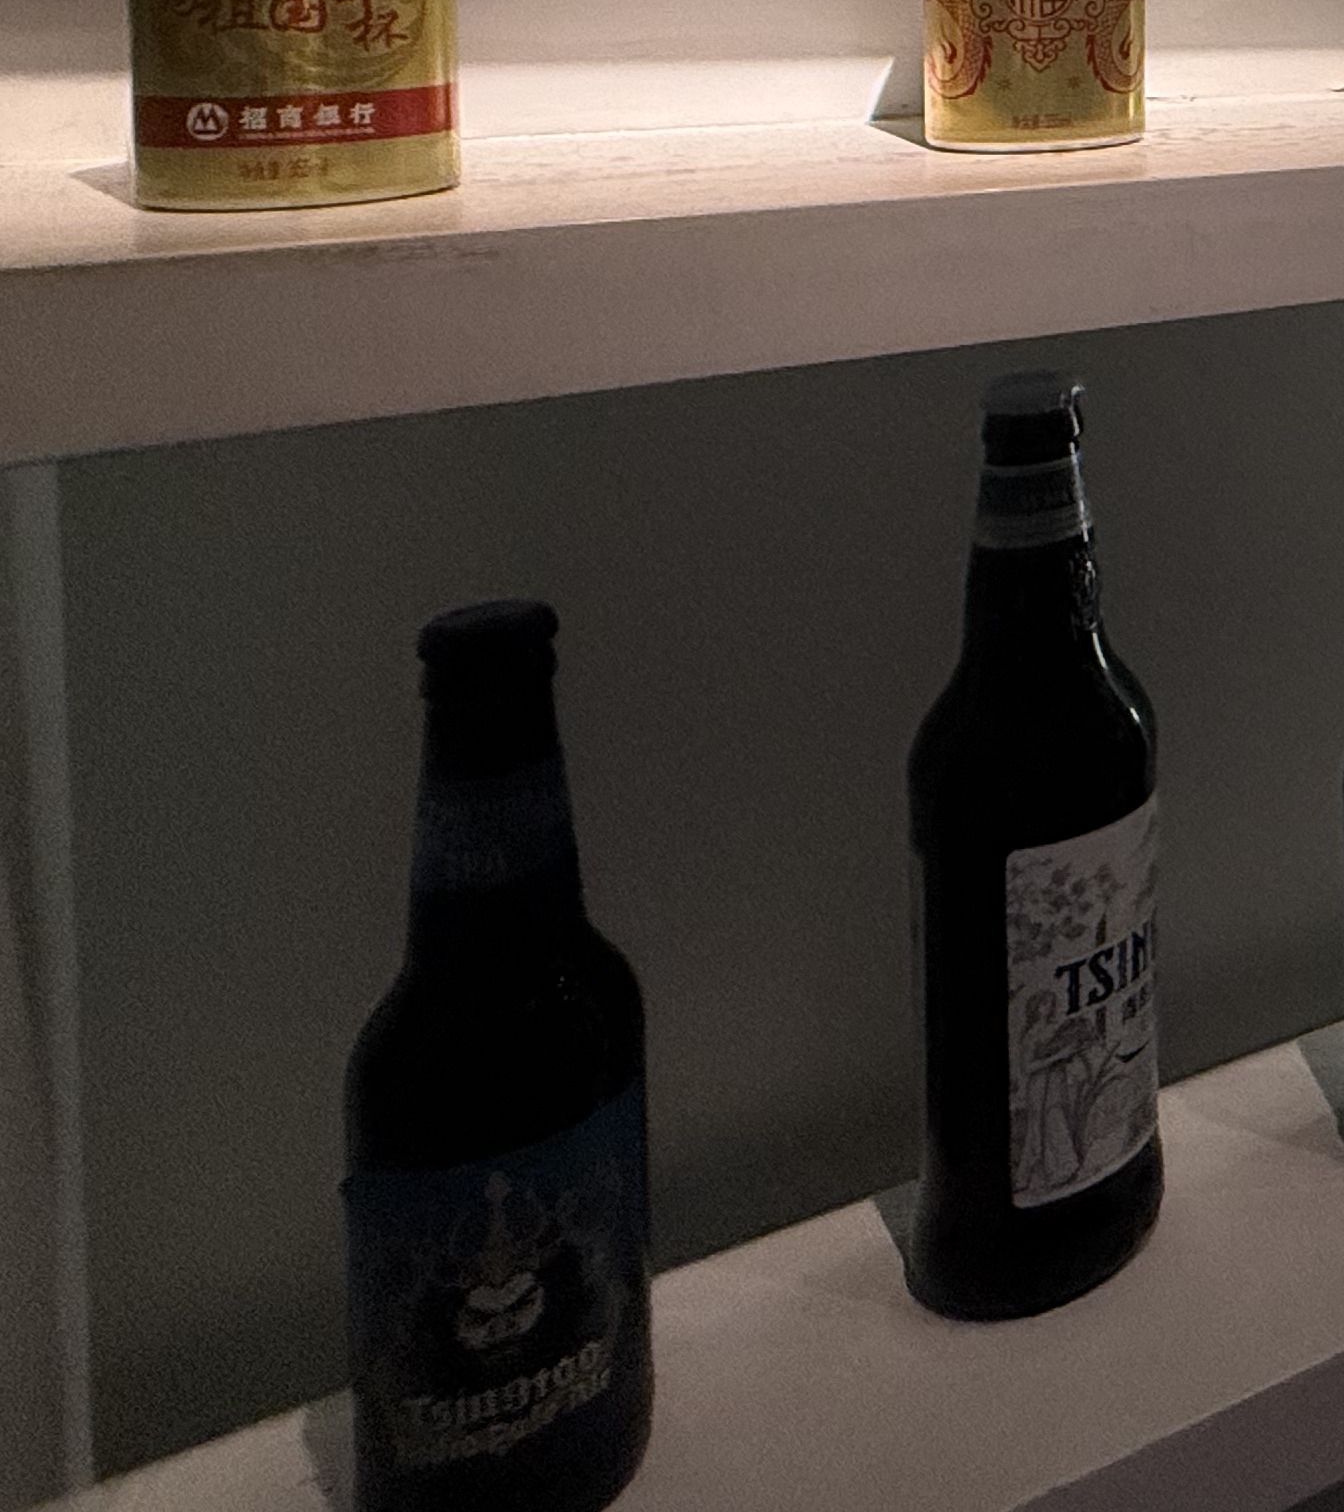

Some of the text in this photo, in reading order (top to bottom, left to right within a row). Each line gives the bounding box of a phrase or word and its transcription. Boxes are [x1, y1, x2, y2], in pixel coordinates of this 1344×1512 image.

[239, 102, 376, 130] 招商银行
[1055, 918, 1156, 1015] TSIN
